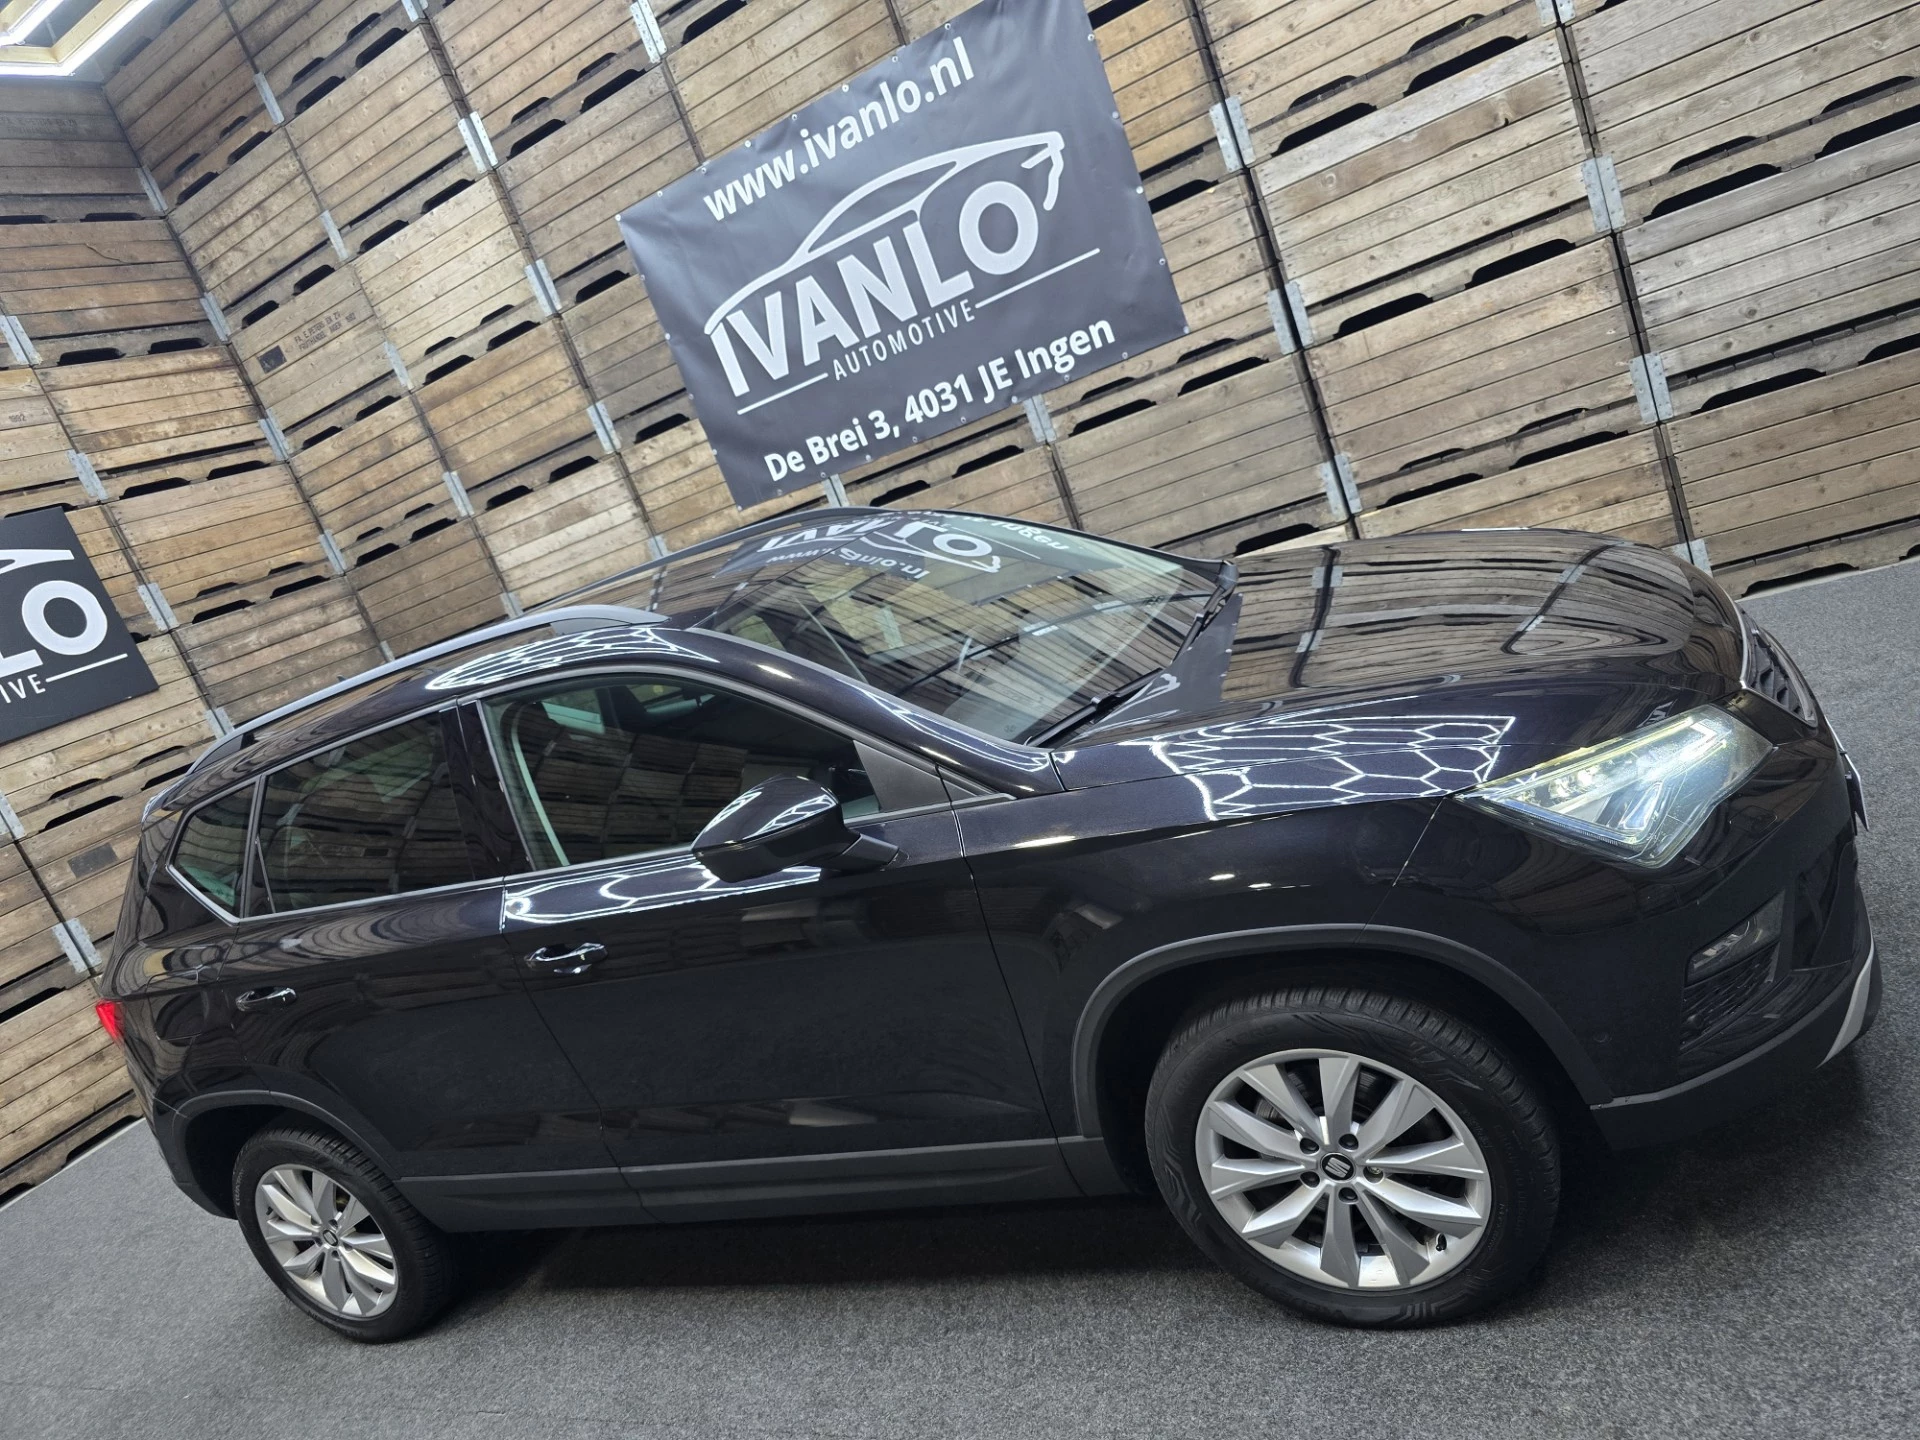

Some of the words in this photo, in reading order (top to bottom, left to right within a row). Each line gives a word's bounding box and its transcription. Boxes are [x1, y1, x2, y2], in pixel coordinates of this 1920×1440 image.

[703, 36, 974, 221] www.ivanlo.nl
[710, 181, 1038, 397] IVANLO
[832, 299, 976, 381] AUTOMOTIVE
[763, 448, 806, 482] De
[806, 417, 869, 465] Brei
[868, 410, 900, 438] 3,
[904, 374, 974, 424] 4031
[978, 357, 1013, 403] JE
[1014, 320, 1116, 374] Ingen
